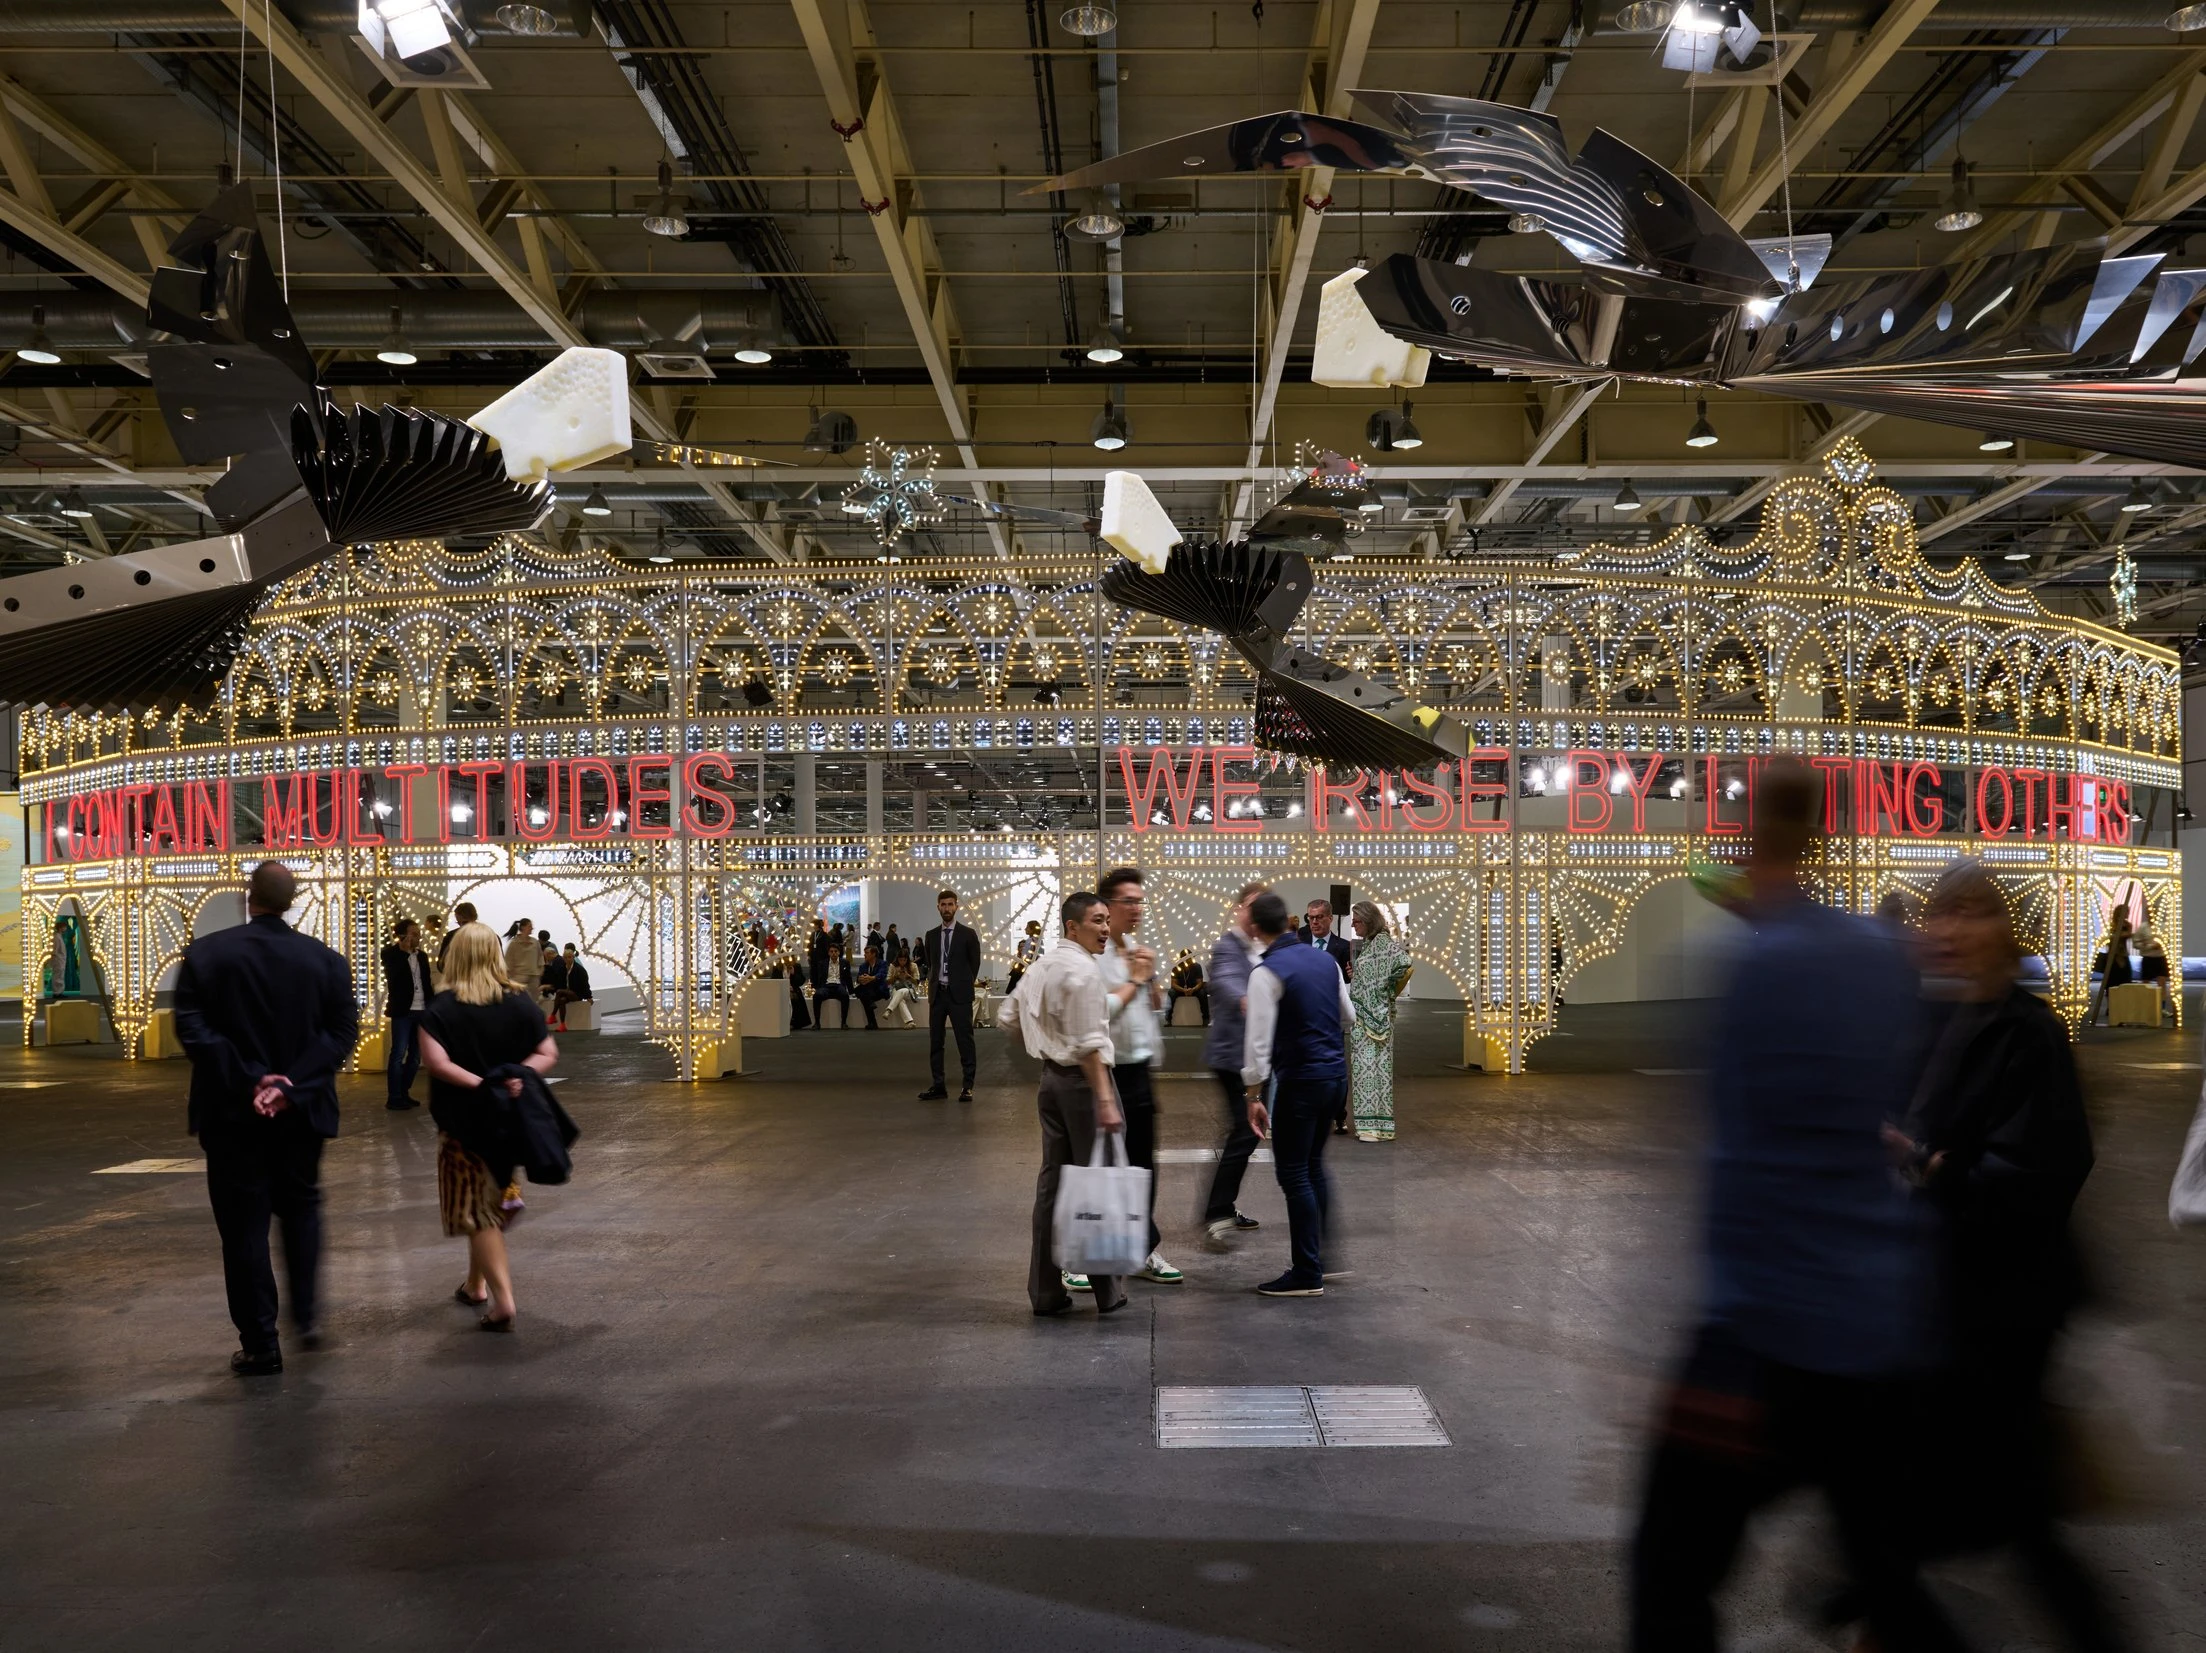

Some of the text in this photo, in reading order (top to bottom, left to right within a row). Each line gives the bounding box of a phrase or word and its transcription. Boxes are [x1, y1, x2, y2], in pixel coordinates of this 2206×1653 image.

[46, 752, 736, 864] I CONTAIN MULTITUDES
[1118, 746, 2130, 846] WE RISE BY LITING OTHERS
